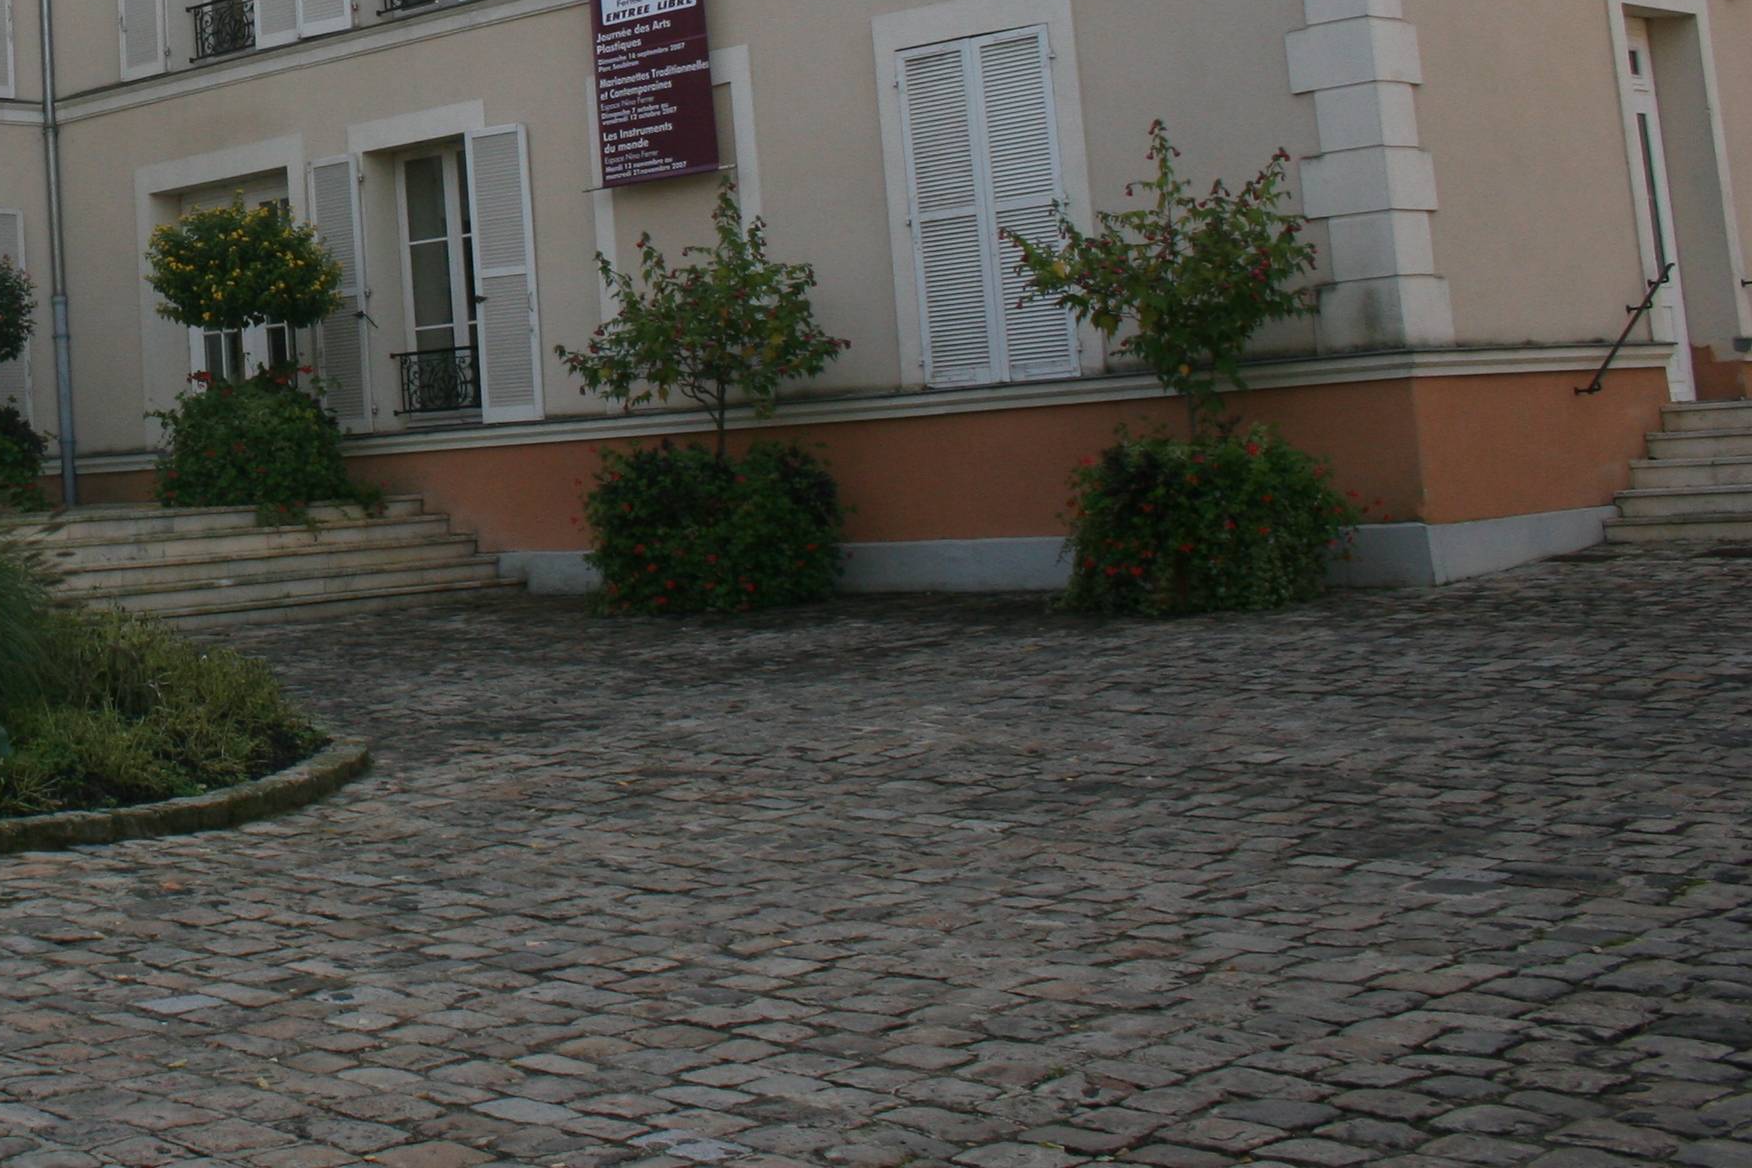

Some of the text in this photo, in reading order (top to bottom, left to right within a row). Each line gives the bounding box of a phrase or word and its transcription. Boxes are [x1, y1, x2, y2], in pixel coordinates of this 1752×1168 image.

[605, 3, 651, 24] ENTREE
[597, 18, 672, 44] Journée des Arts
[597, 37, 643, 55] Plastiques
[600, 71, 650, 89] Marionnettes
[600, 79, 673, 101] et Contemporaines
[603, 121, 673, 143] Les Instruments
[604, 138, 650, 154] du monde
[671, 159, 688, 171] 2007
